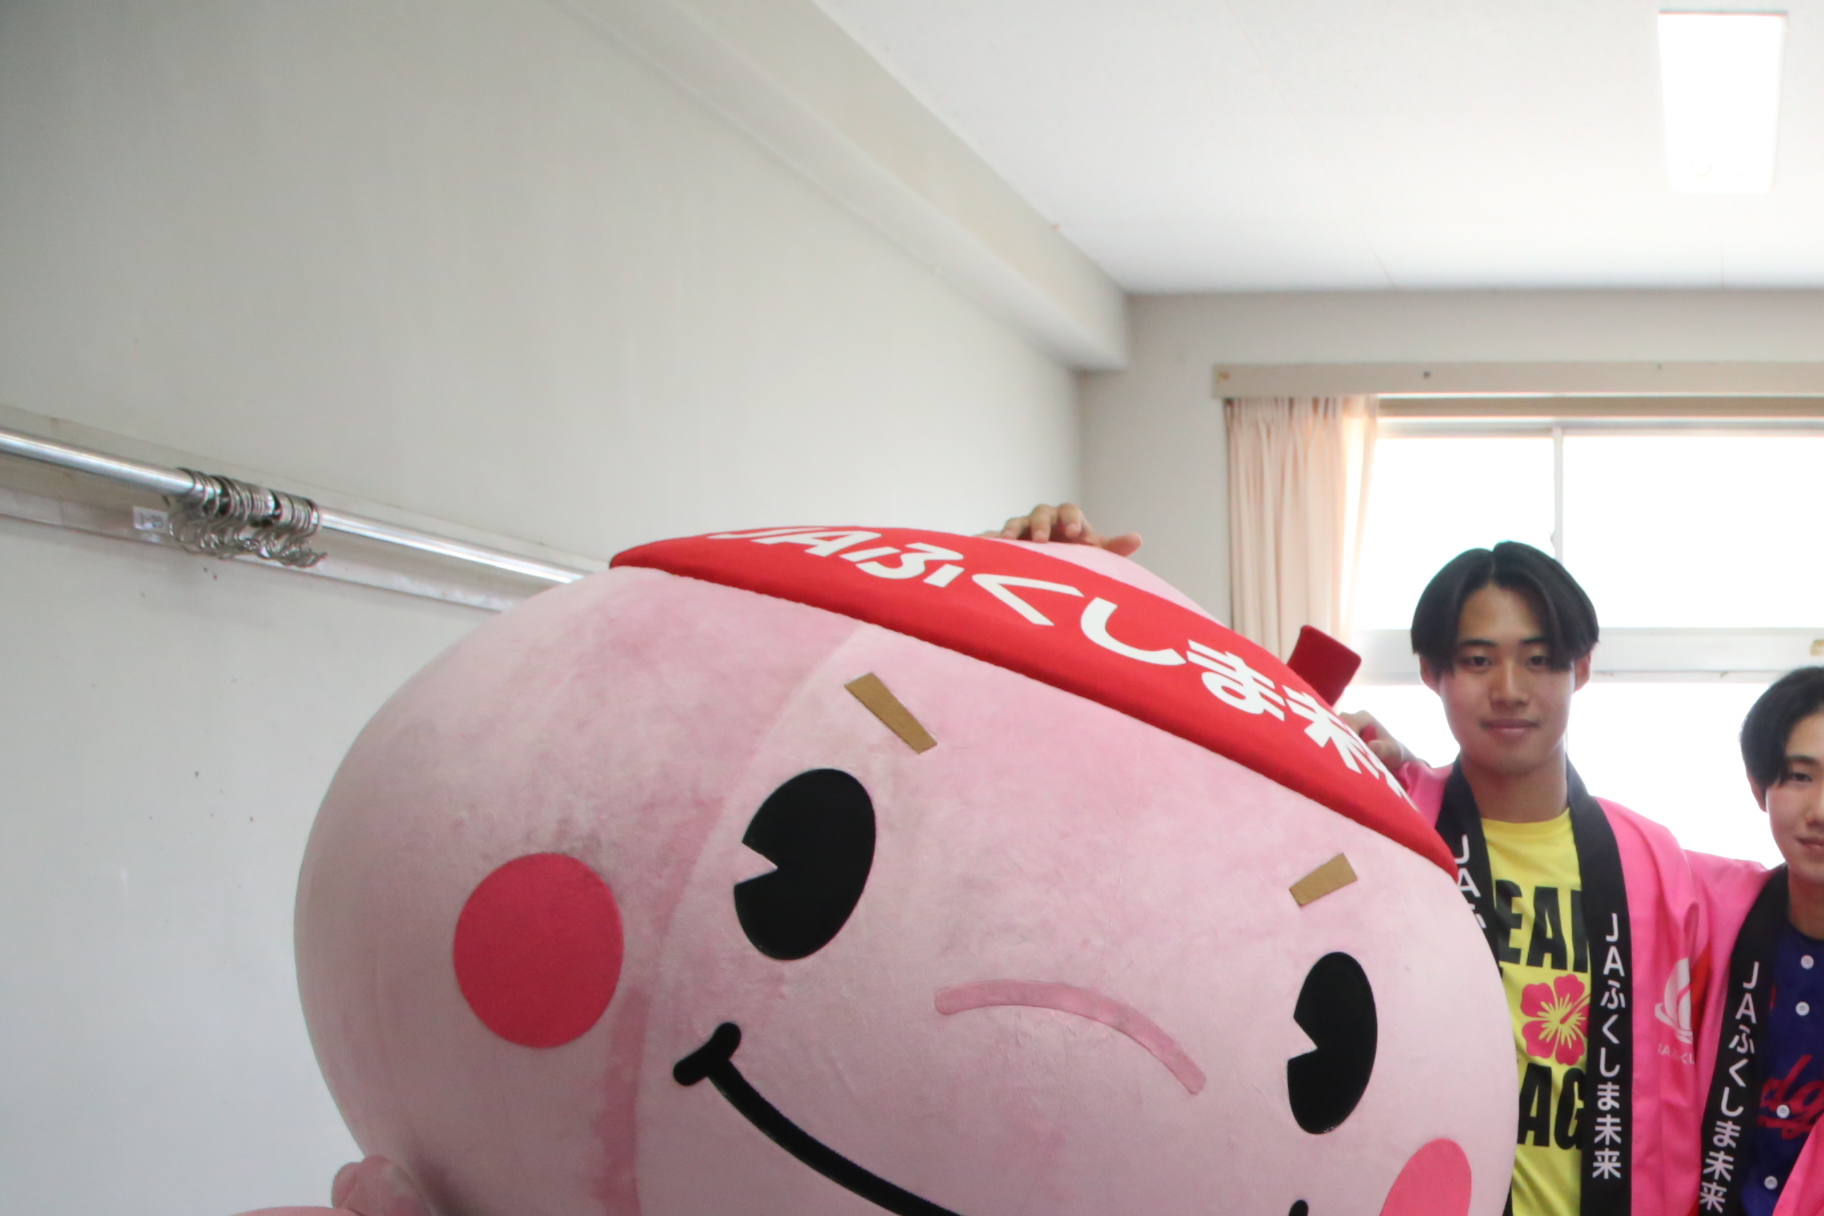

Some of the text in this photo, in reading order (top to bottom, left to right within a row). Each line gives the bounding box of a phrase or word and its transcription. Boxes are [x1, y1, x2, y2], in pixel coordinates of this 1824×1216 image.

[706, 526, 1422, 813] JAふくしま未
[1591, 912, 1627, 1180] JAふくしま未来
[1700, 961, 1760, 1214] JAふくしま未来
